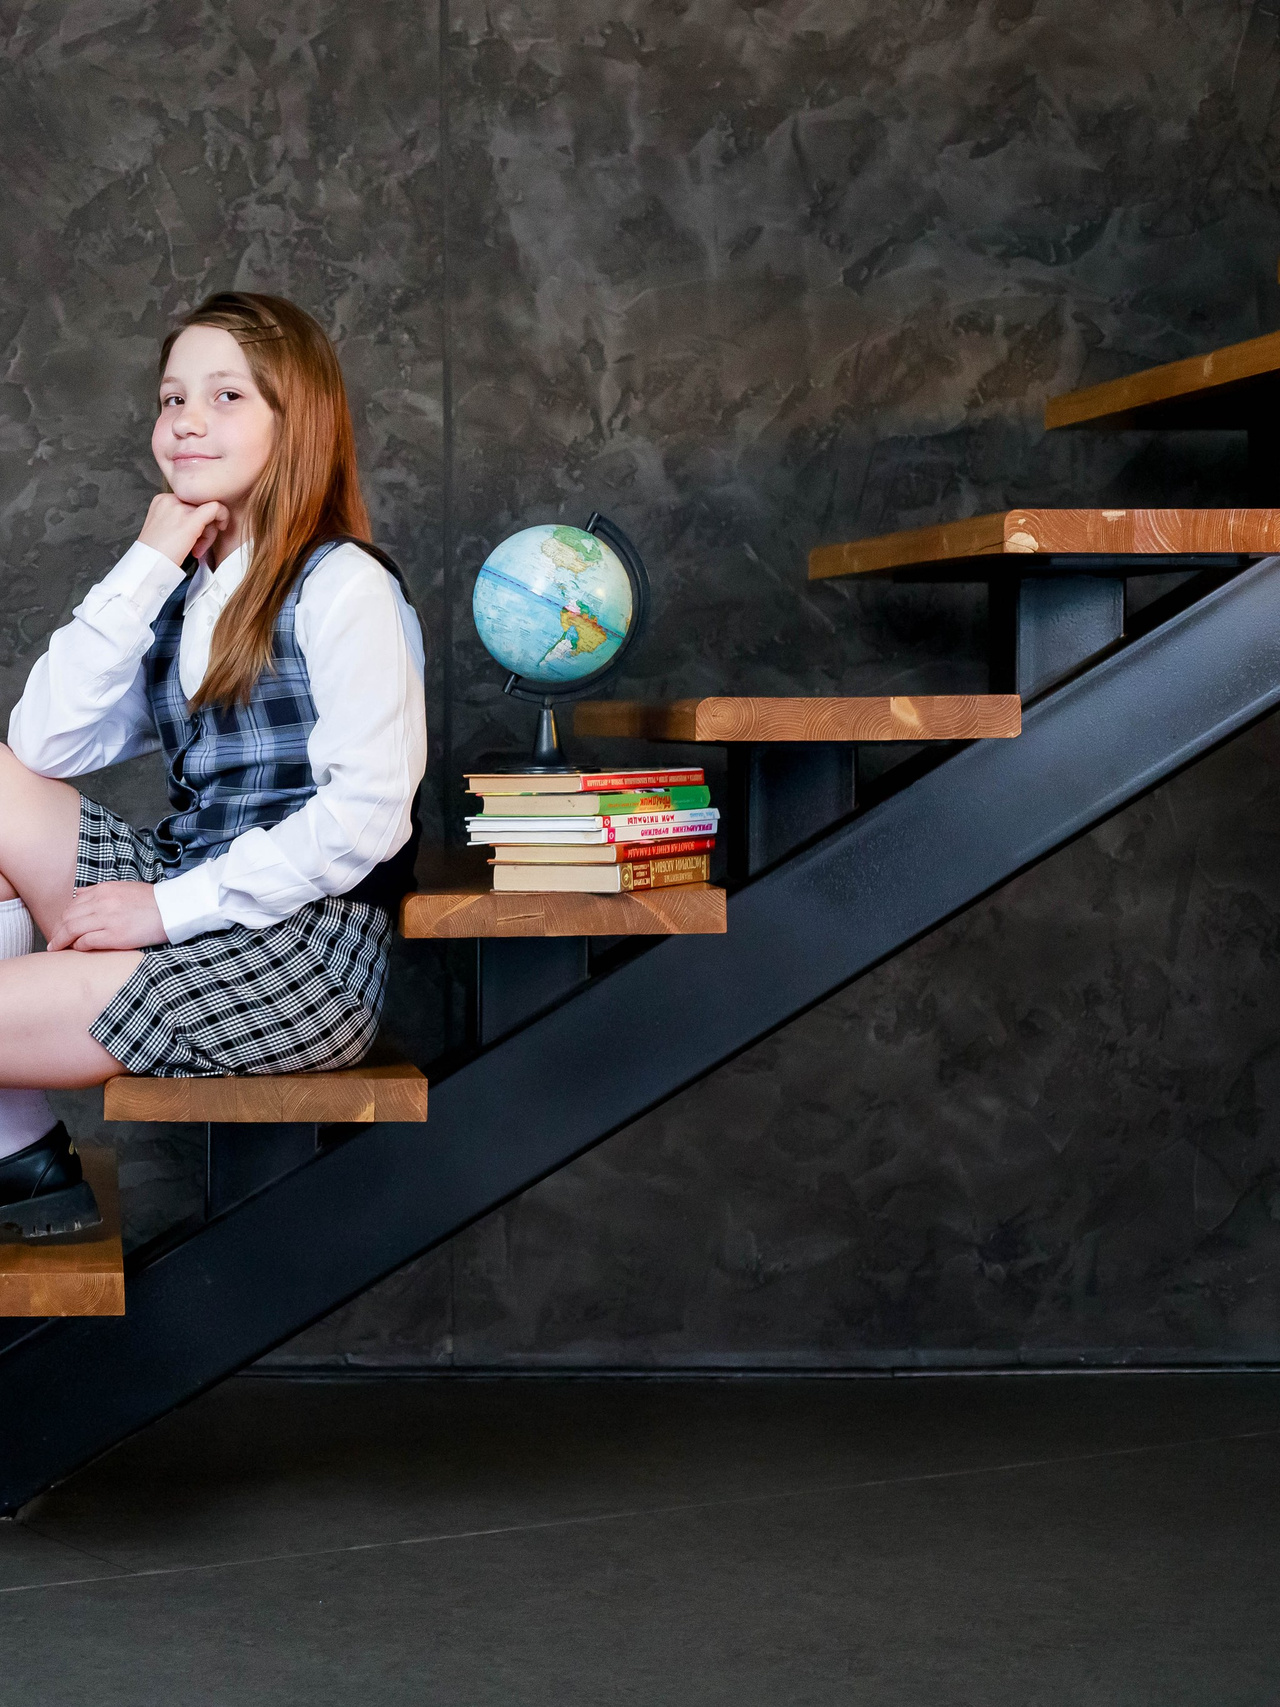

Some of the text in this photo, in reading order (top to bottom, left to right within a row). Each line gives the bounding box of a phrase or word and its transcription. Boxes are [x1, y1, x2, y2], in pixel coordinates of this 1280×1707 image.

[671, 823, 713, 833] ПРИКЛЮЧЕНИЯ
[627, 846, 651, 858] ТАМАДЫ
[652, 844, 671, 856] КНИГА
[670, 841, 695, 853] ЗОЛОТАЯ
[675, 856, 702, 871] ИСТОРИИ
